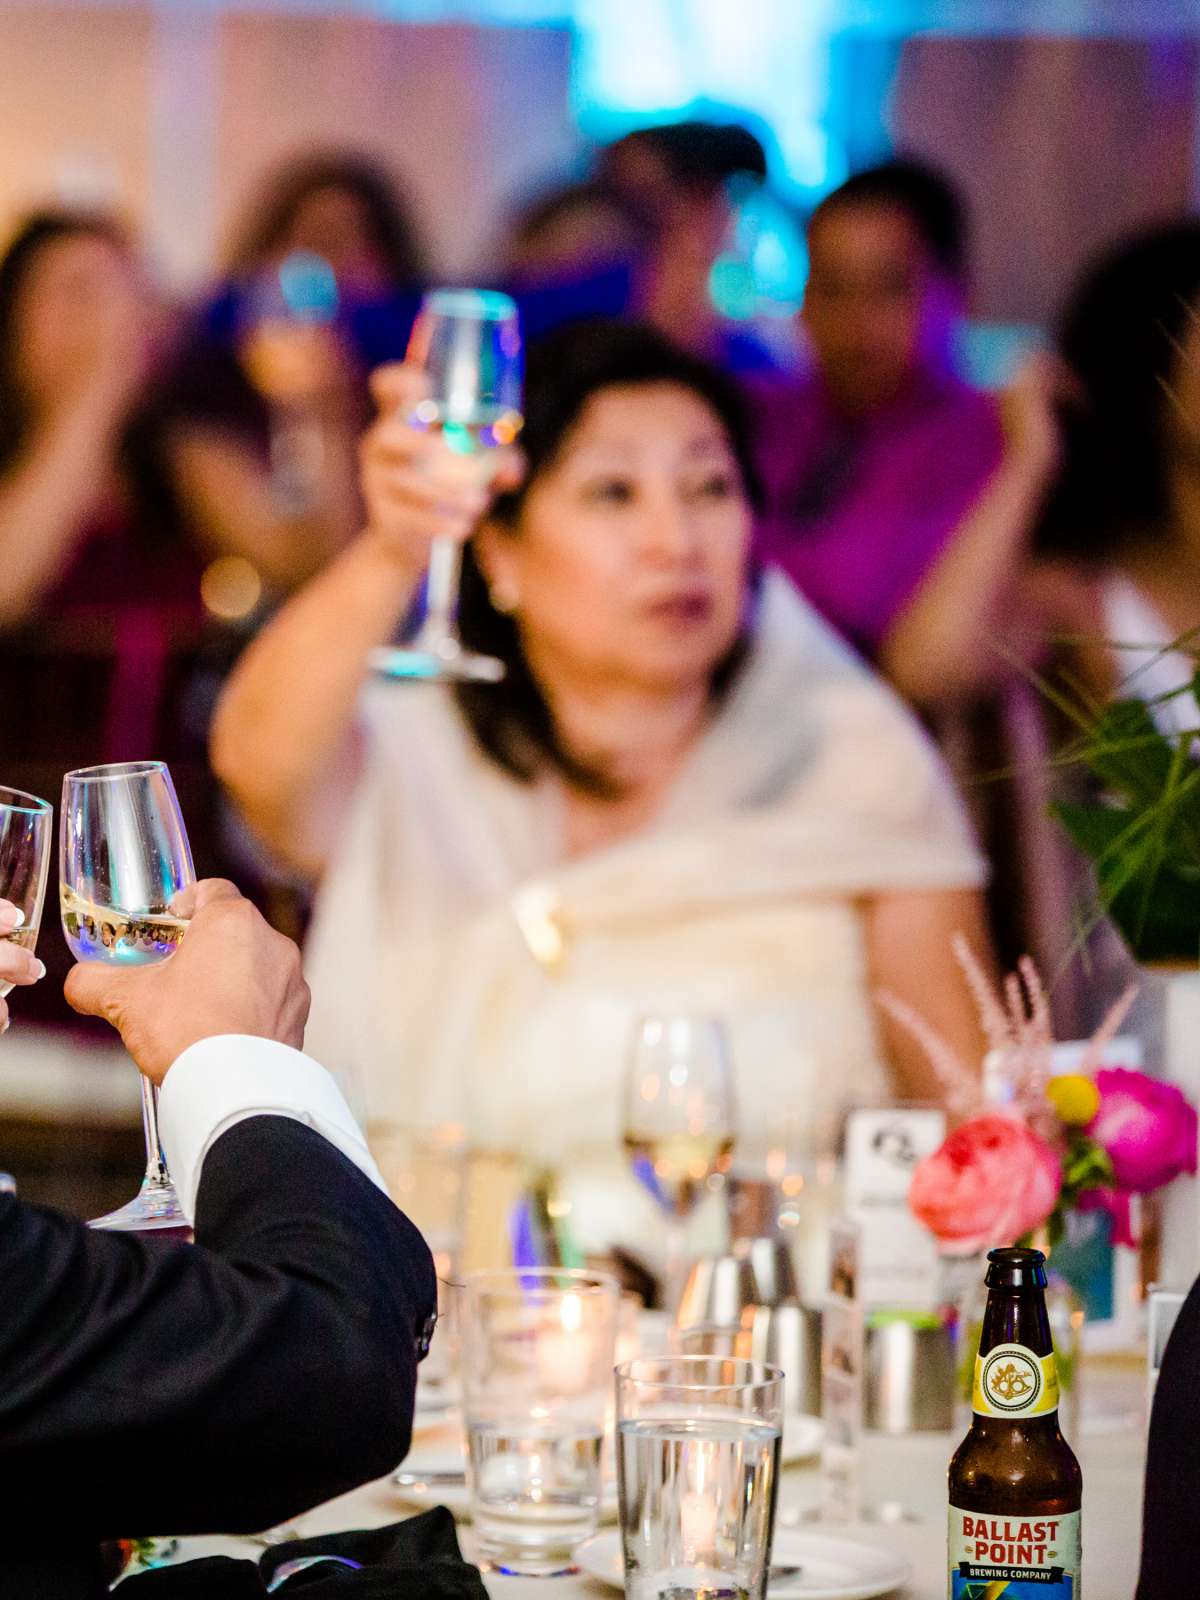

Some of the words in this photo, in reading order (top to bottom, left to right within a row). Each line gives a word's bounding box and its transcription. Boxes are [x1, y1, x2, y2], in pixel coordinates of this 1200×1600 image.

[963, 1516, 1059, 1542] BALLAST
[975, 1541, 1048, 1564] POINT
[969, 1568, 1008, 1578] BREWING
[1010, 1569, 1052, 1580] COMPANY
